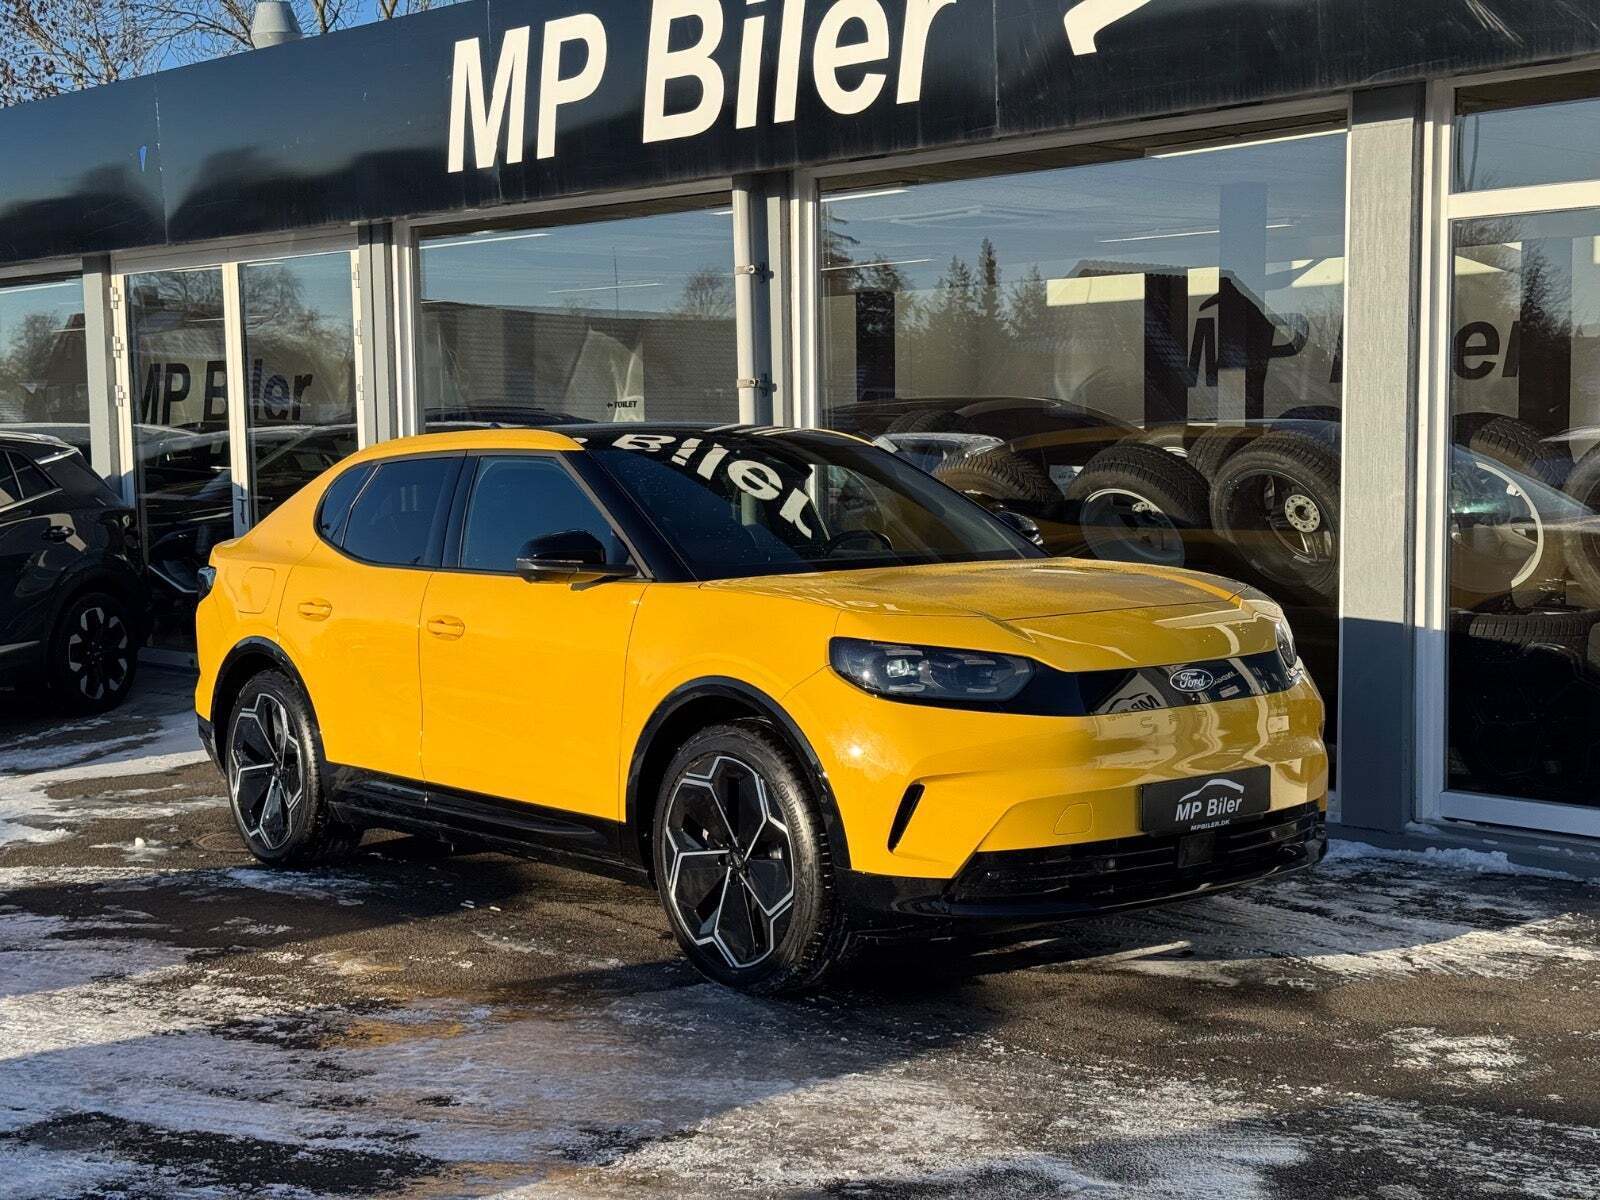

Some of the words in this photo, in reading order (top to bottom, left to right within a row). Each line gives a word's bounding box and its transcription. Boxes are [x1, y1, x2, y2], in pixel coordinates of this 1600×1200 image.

[447, 14, 608, 174] MP
[642, 0, 957, 144] Biler
[614, 400, 637, 409] TOILET
[1175, 801, 1202, 822] MP
[1206, 796, 1243, 817] Biler
[1190, 819, 1231, 832] MPBILER.DK
